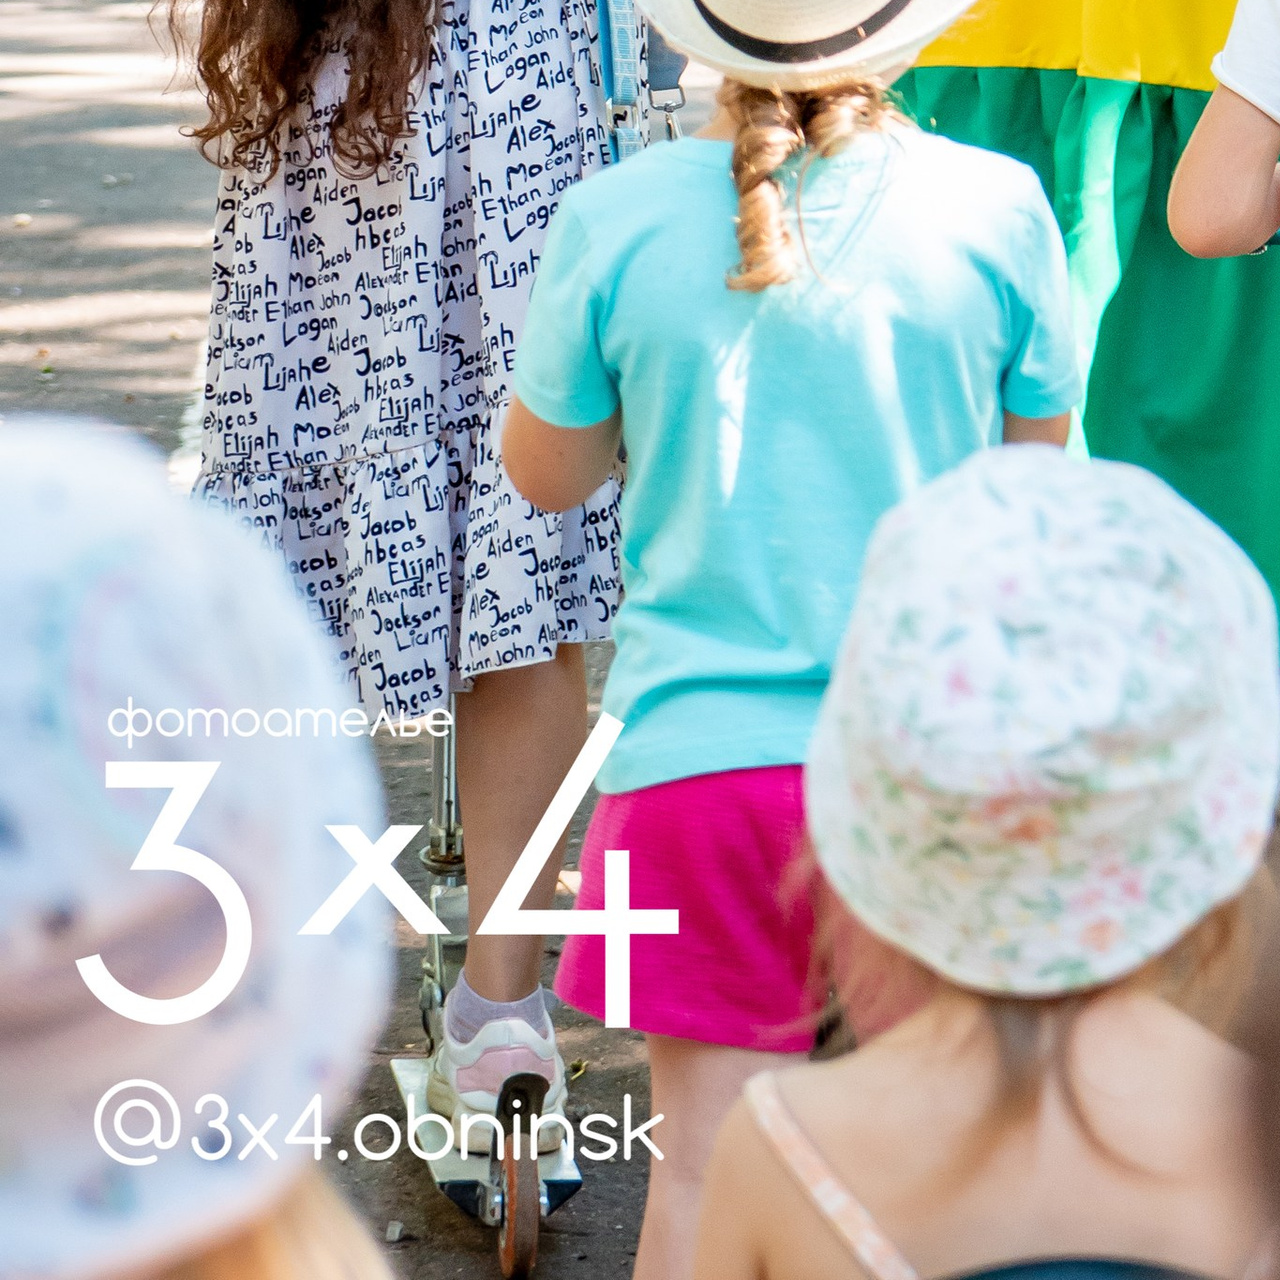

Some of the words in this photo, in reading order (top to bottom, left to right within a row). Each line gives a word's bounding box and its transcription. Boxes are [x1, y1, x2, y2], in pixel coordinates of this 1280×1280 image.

[468, 41, 518, 72] Ethan
[525, 25, 558, 48] John
[485, 52, 550, 95] Logan
[507, 119, 555, 153] Alex
[285, 167, 327, 189] ogan
[313, 179, 358, 206] Aiden
[482, 188, 541, 221] Ethan
[291, 233, 325, 260] Alex
[316, 247, 351, 271] Jacob
[383, 235, 427, 271] Elijah
[319, 290, 350, 311] John
[283, 317, 337, 347] Logan
[328, 329, 367, 355] Aiden
[295, 382, 341, 411] Alex
[379, 386, 433, 422] Elijah
[224, 425, 278, 458] Elijah
[268, 450, 327, 470] Ethan
[361, 510, 417, 540] Jacob
[487, 529, 533, 559] Aiden
[388, 545, 445, 586] Elijah
[470, 588, 500, 620] Alex
[489, 597, 533, 628] Jacob
[371, 658, 436, 691] Jacob
